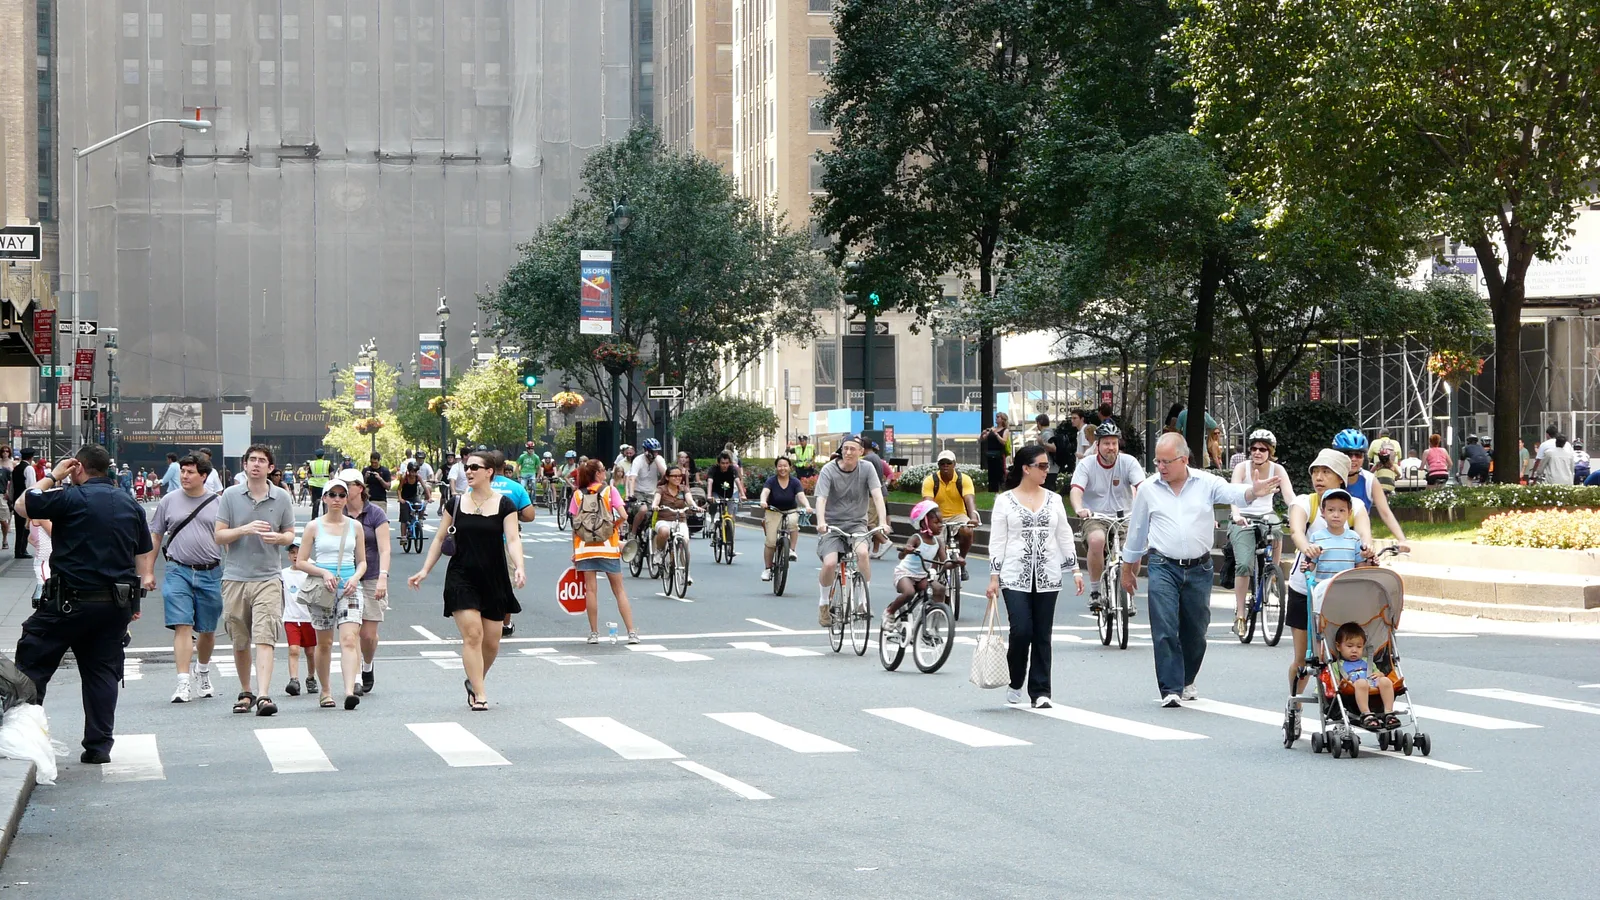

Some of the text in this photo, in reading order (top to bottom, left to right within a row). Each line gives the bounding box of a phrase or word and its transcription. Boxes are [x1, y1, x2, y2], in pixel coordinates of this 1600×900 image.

[270, 408, 292, 422] The
[293, 410, 325, 422] Crown
[560, 581, 587, 600] TOP
